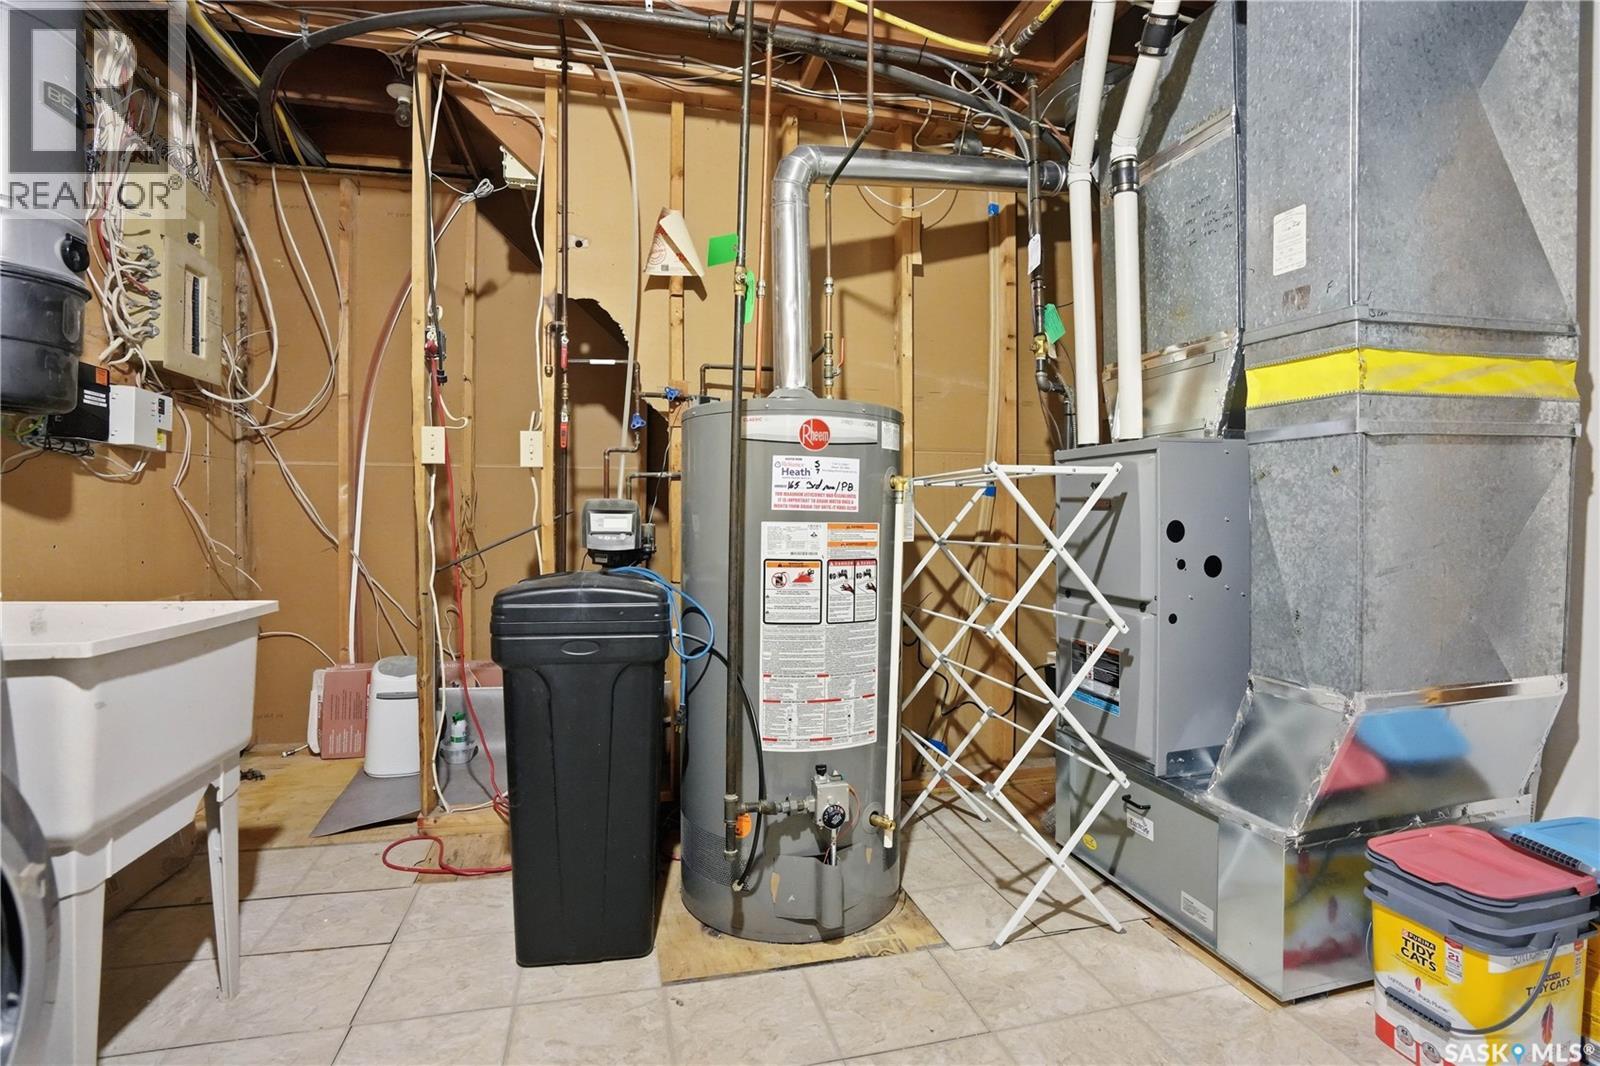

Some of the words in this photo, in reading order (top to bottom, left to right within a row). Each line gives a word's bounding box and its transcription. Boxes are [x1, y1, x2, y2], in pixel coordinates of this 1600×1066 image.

[802, 418, 829, 446] Rheem
[781, 467, 811, 476] Heath
[1401, 936, 1435, 960] TIDY
[1447, 952, 1460, 963] 21
[1400, 947, 1437, 972] CATS
[1526, 982, 1550, 997] TY
[1549, 976, 1571, 991] CATS
